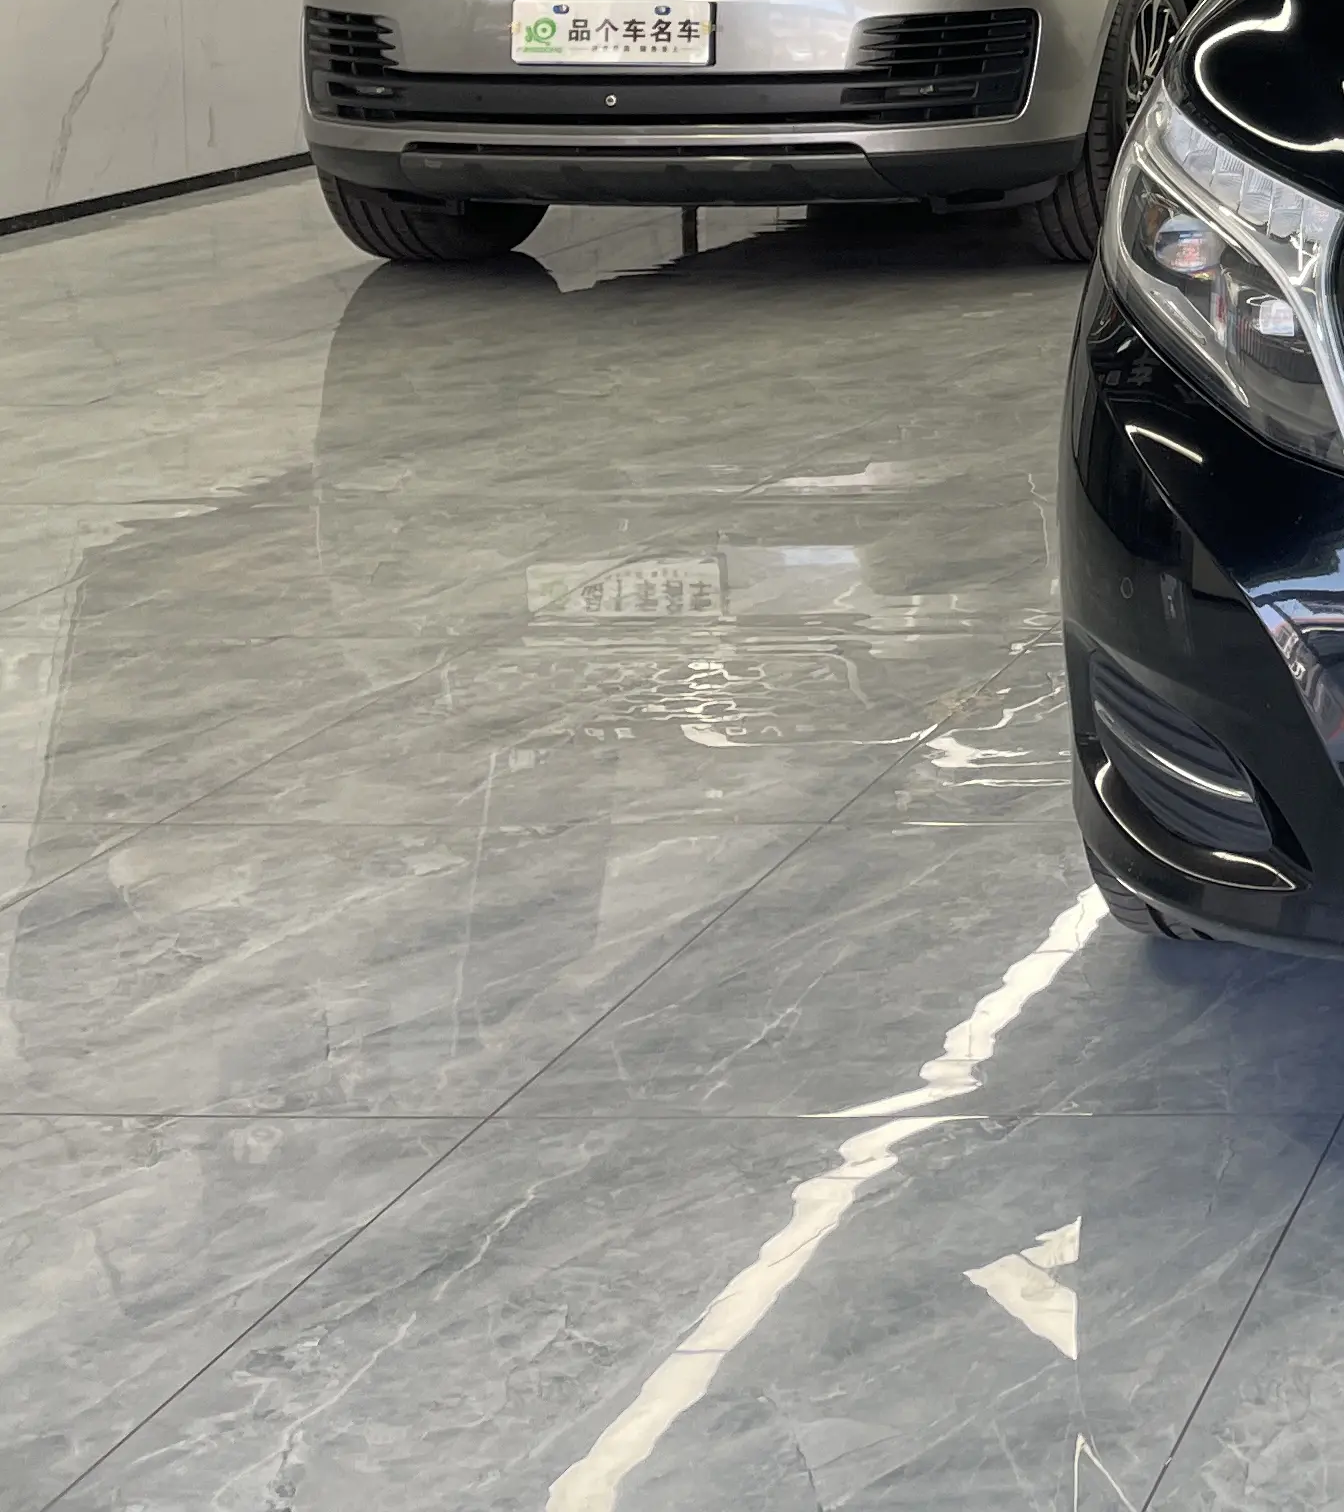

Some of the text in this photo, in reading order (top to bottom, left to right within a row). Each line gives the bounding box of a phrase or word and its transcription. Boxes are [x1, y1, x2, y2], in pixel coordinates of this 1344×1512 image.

[568, 18, 700, 43] 品个车名车
